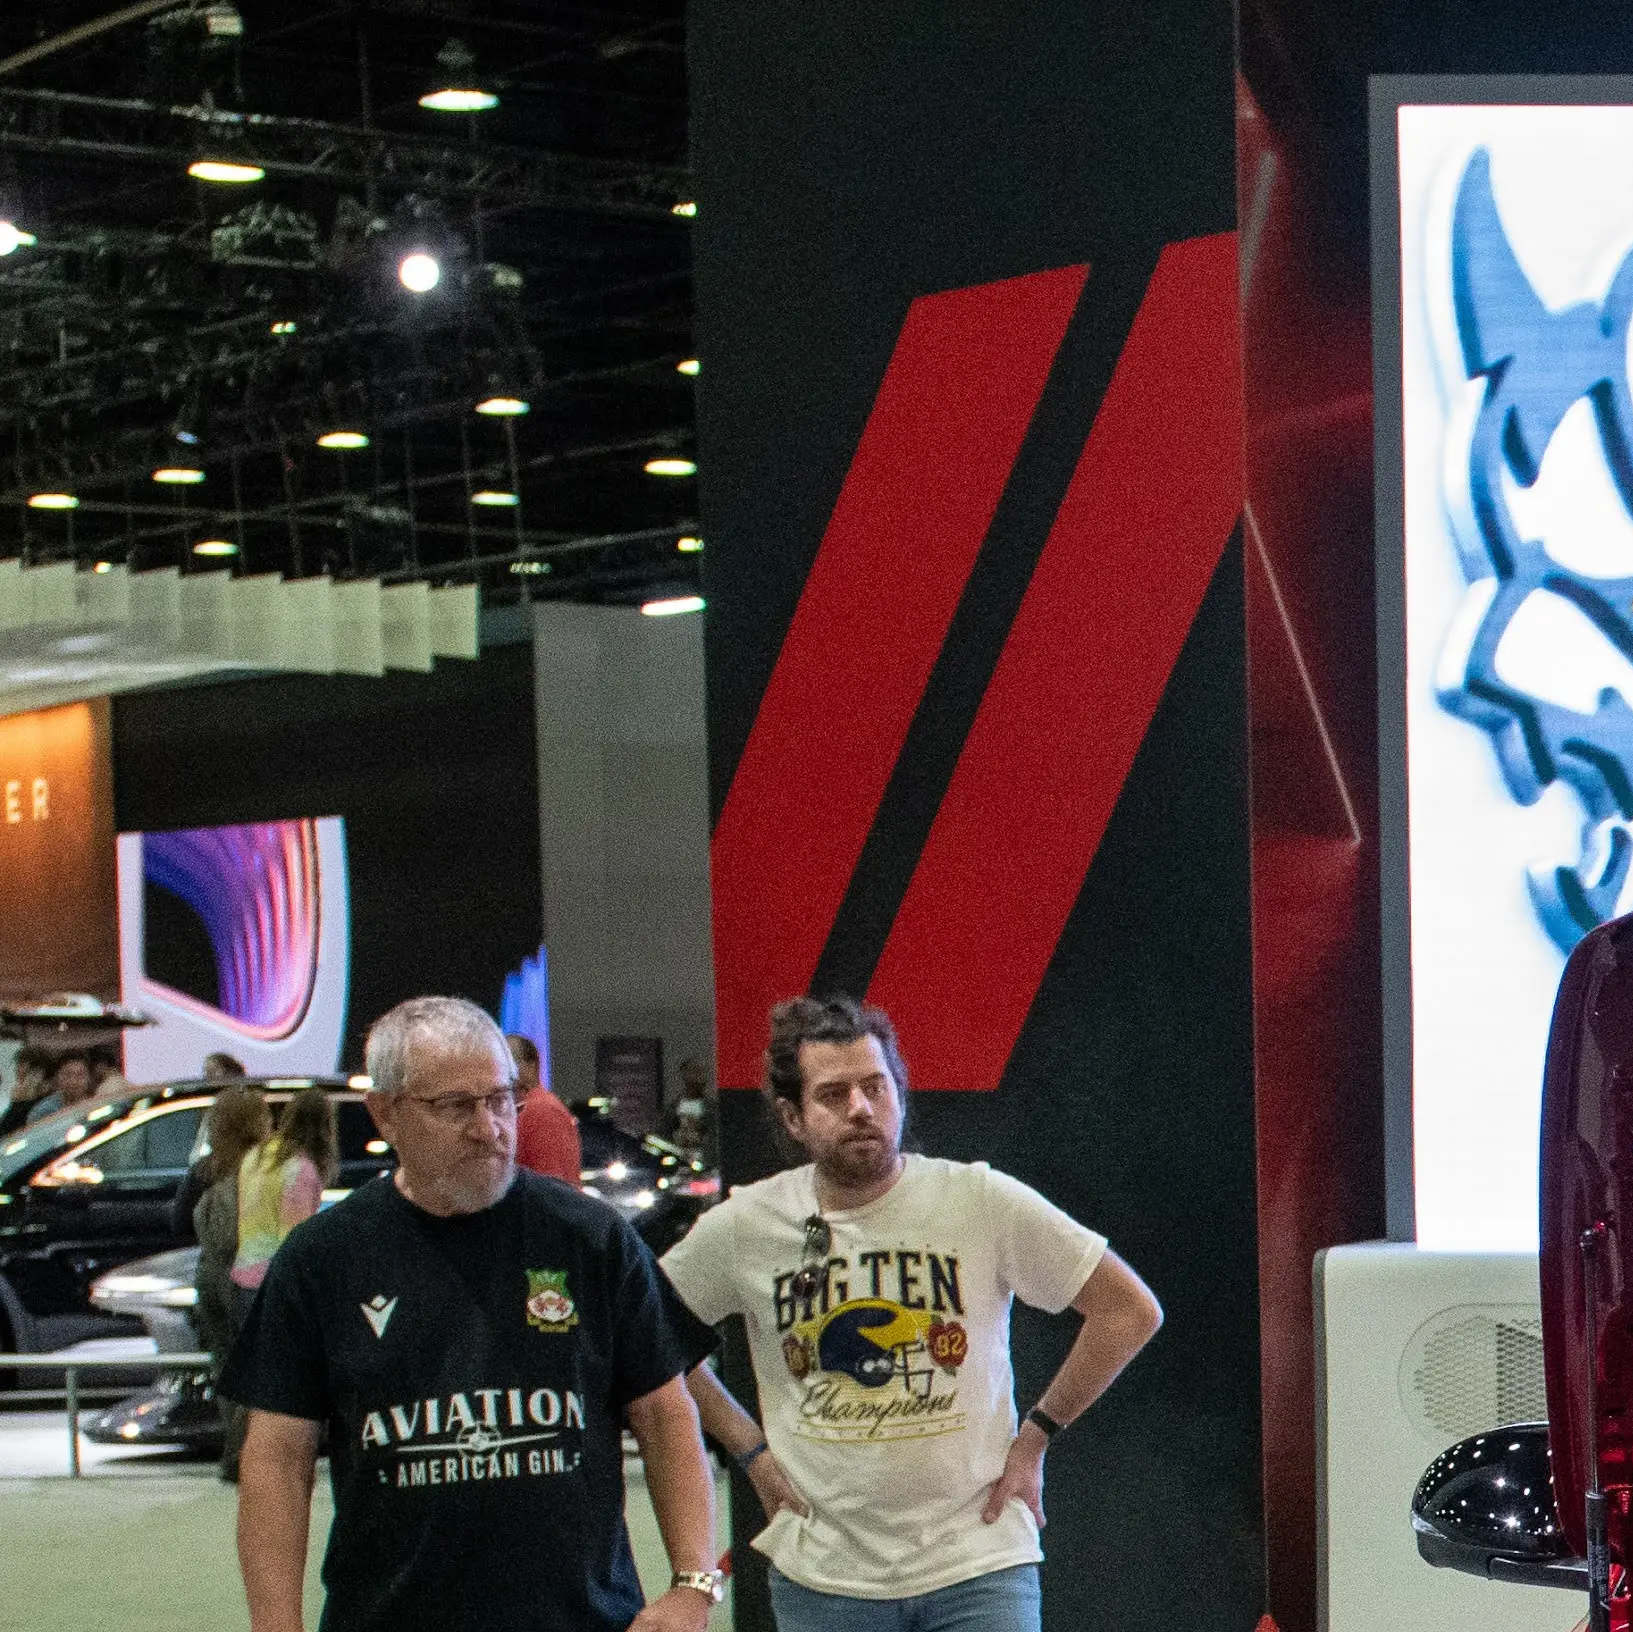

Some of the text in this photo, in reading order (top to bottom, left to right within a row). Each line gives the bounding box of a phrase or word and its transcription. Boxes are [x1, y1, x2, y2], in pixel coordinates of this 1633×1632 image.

[5, 776, 49, 824] ER
[859, 1250, 967, 1317] TEN
[362, 1387, 586, 1450] AVIATION
[801, 1378, 959, 1438] Champions
[397, 1448, 564, 1488] AMERICAN GIN
